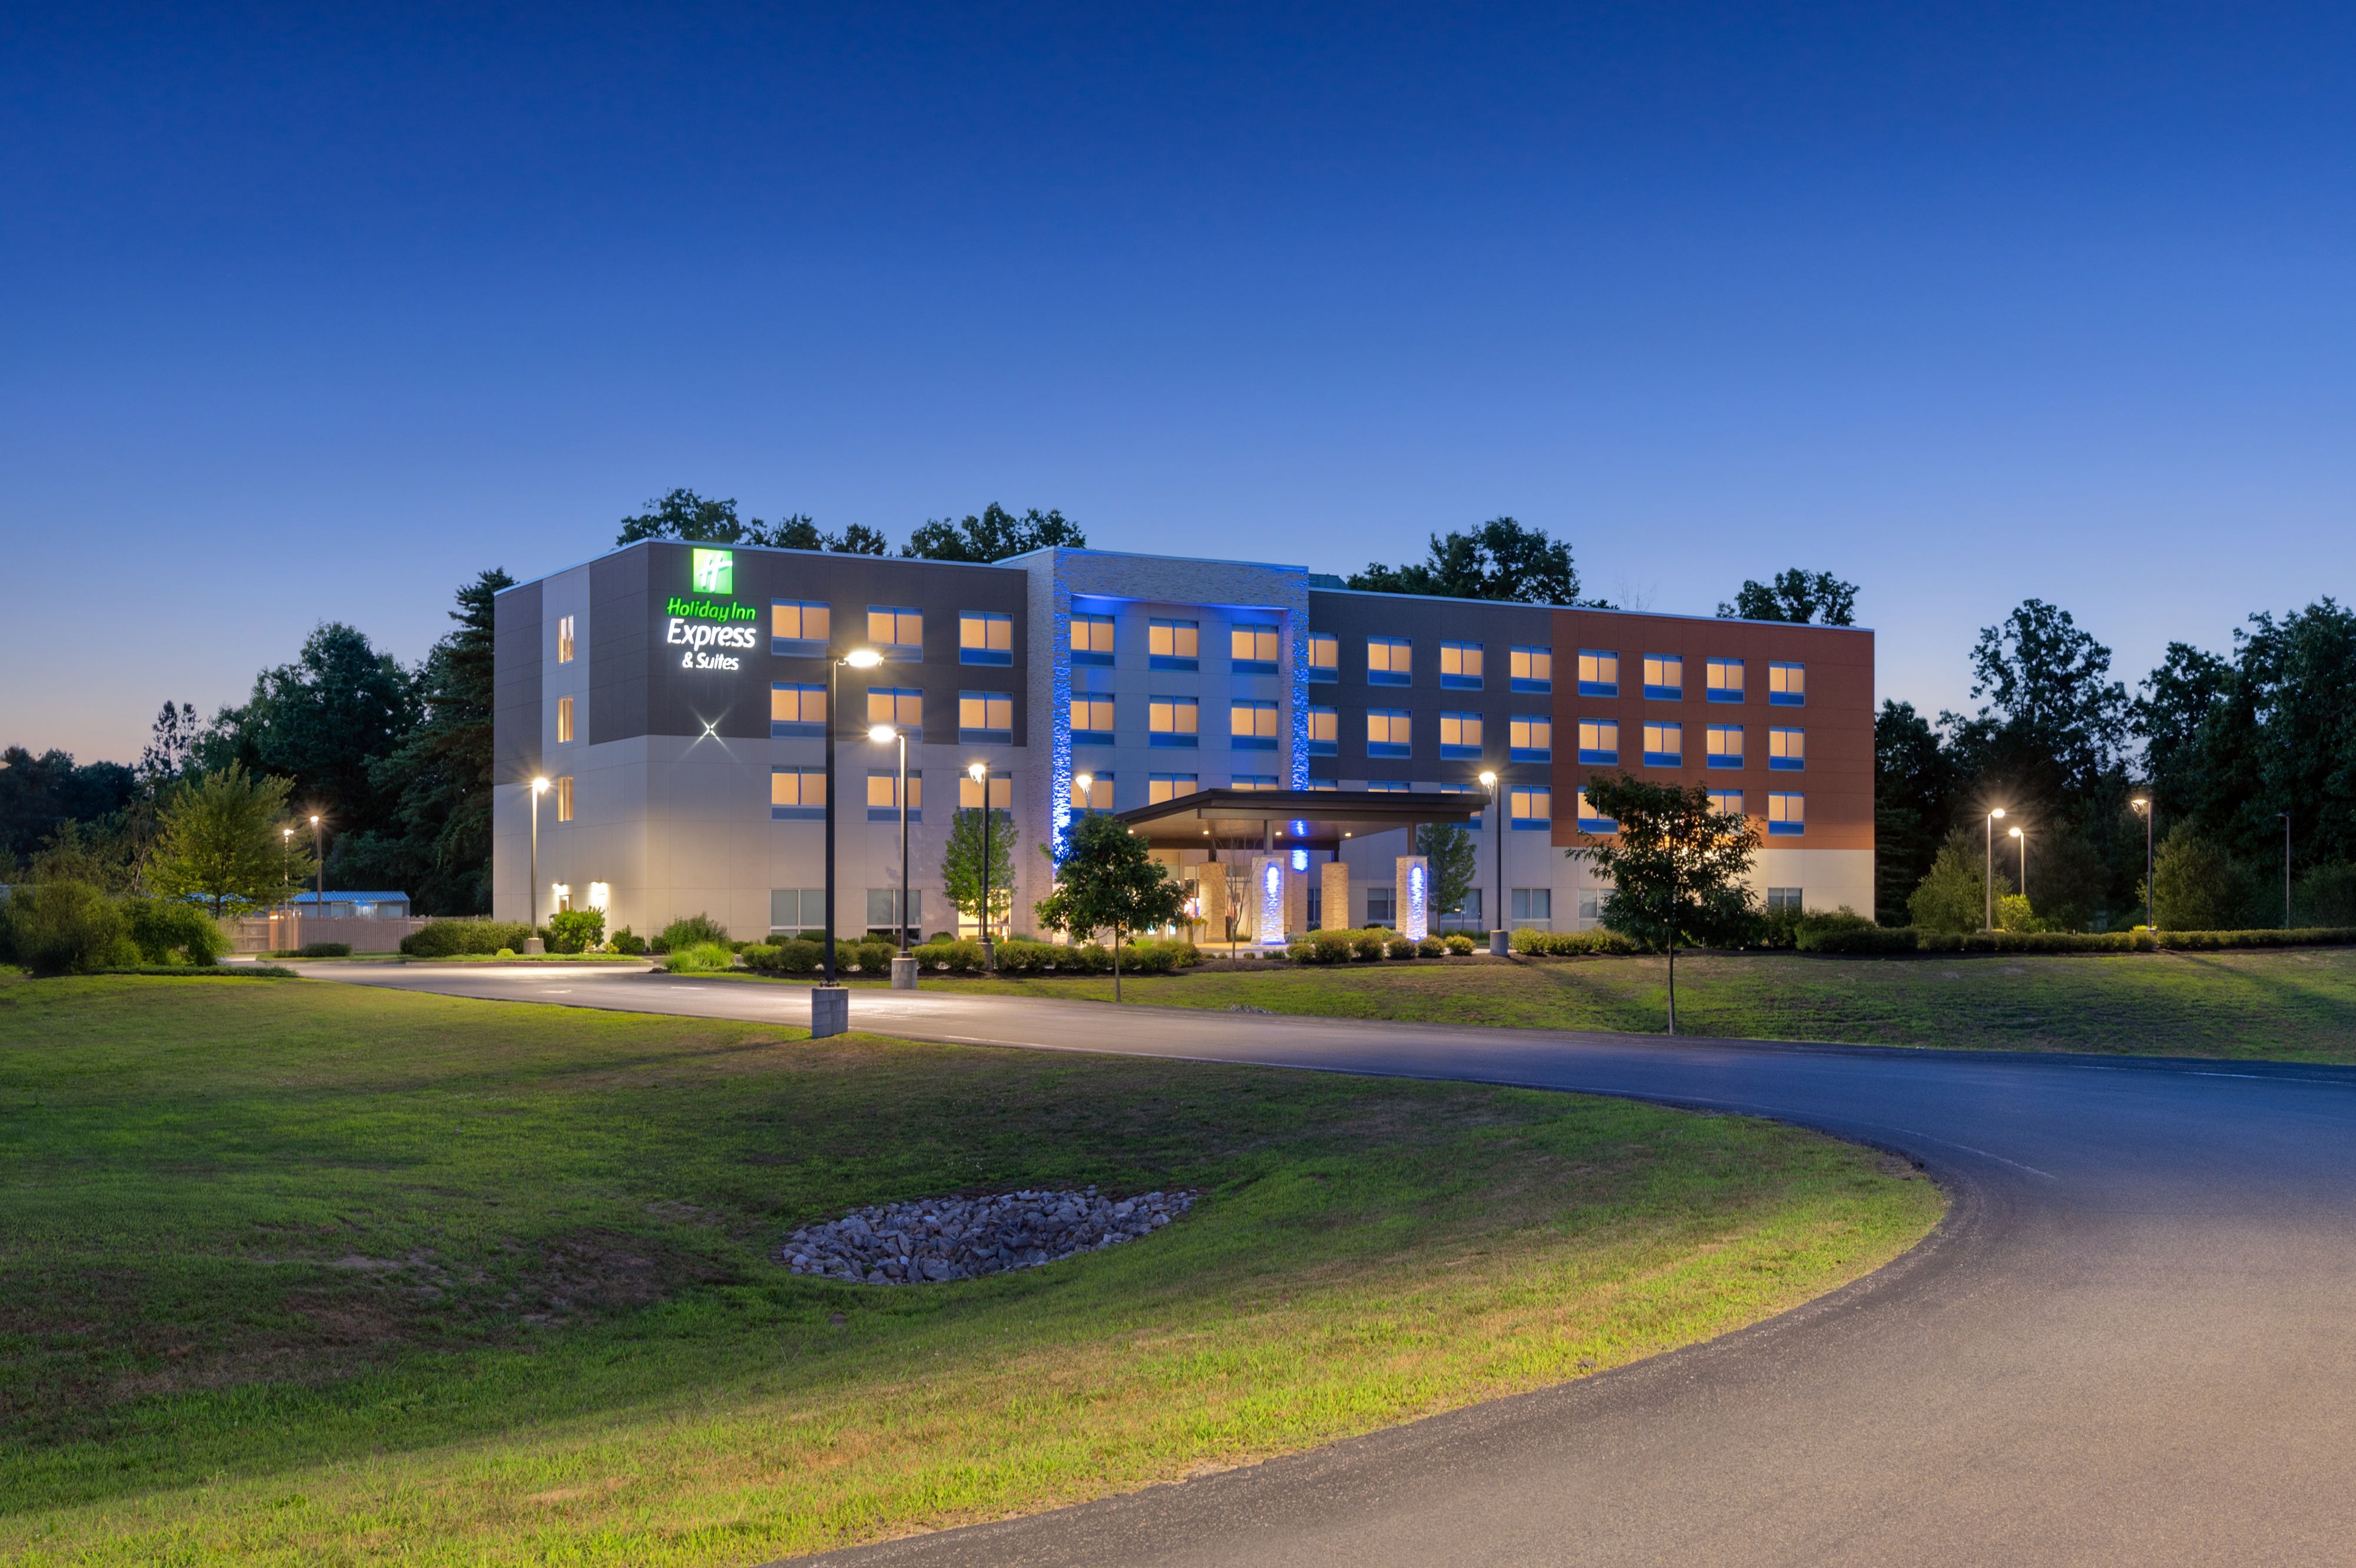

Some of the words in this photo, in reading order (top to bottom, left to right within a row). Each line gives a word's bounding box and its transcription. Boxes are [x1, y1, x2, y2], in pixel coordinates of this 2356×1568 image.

[697, 551, 733, 593] H
[667, 597, 729, 622] Holiday
[731, 601, 756, 620] Inn
[667, 618, 756, 651] Express
[682, 651, 693, 668] &
[696, 652, 739, 670] Suites
